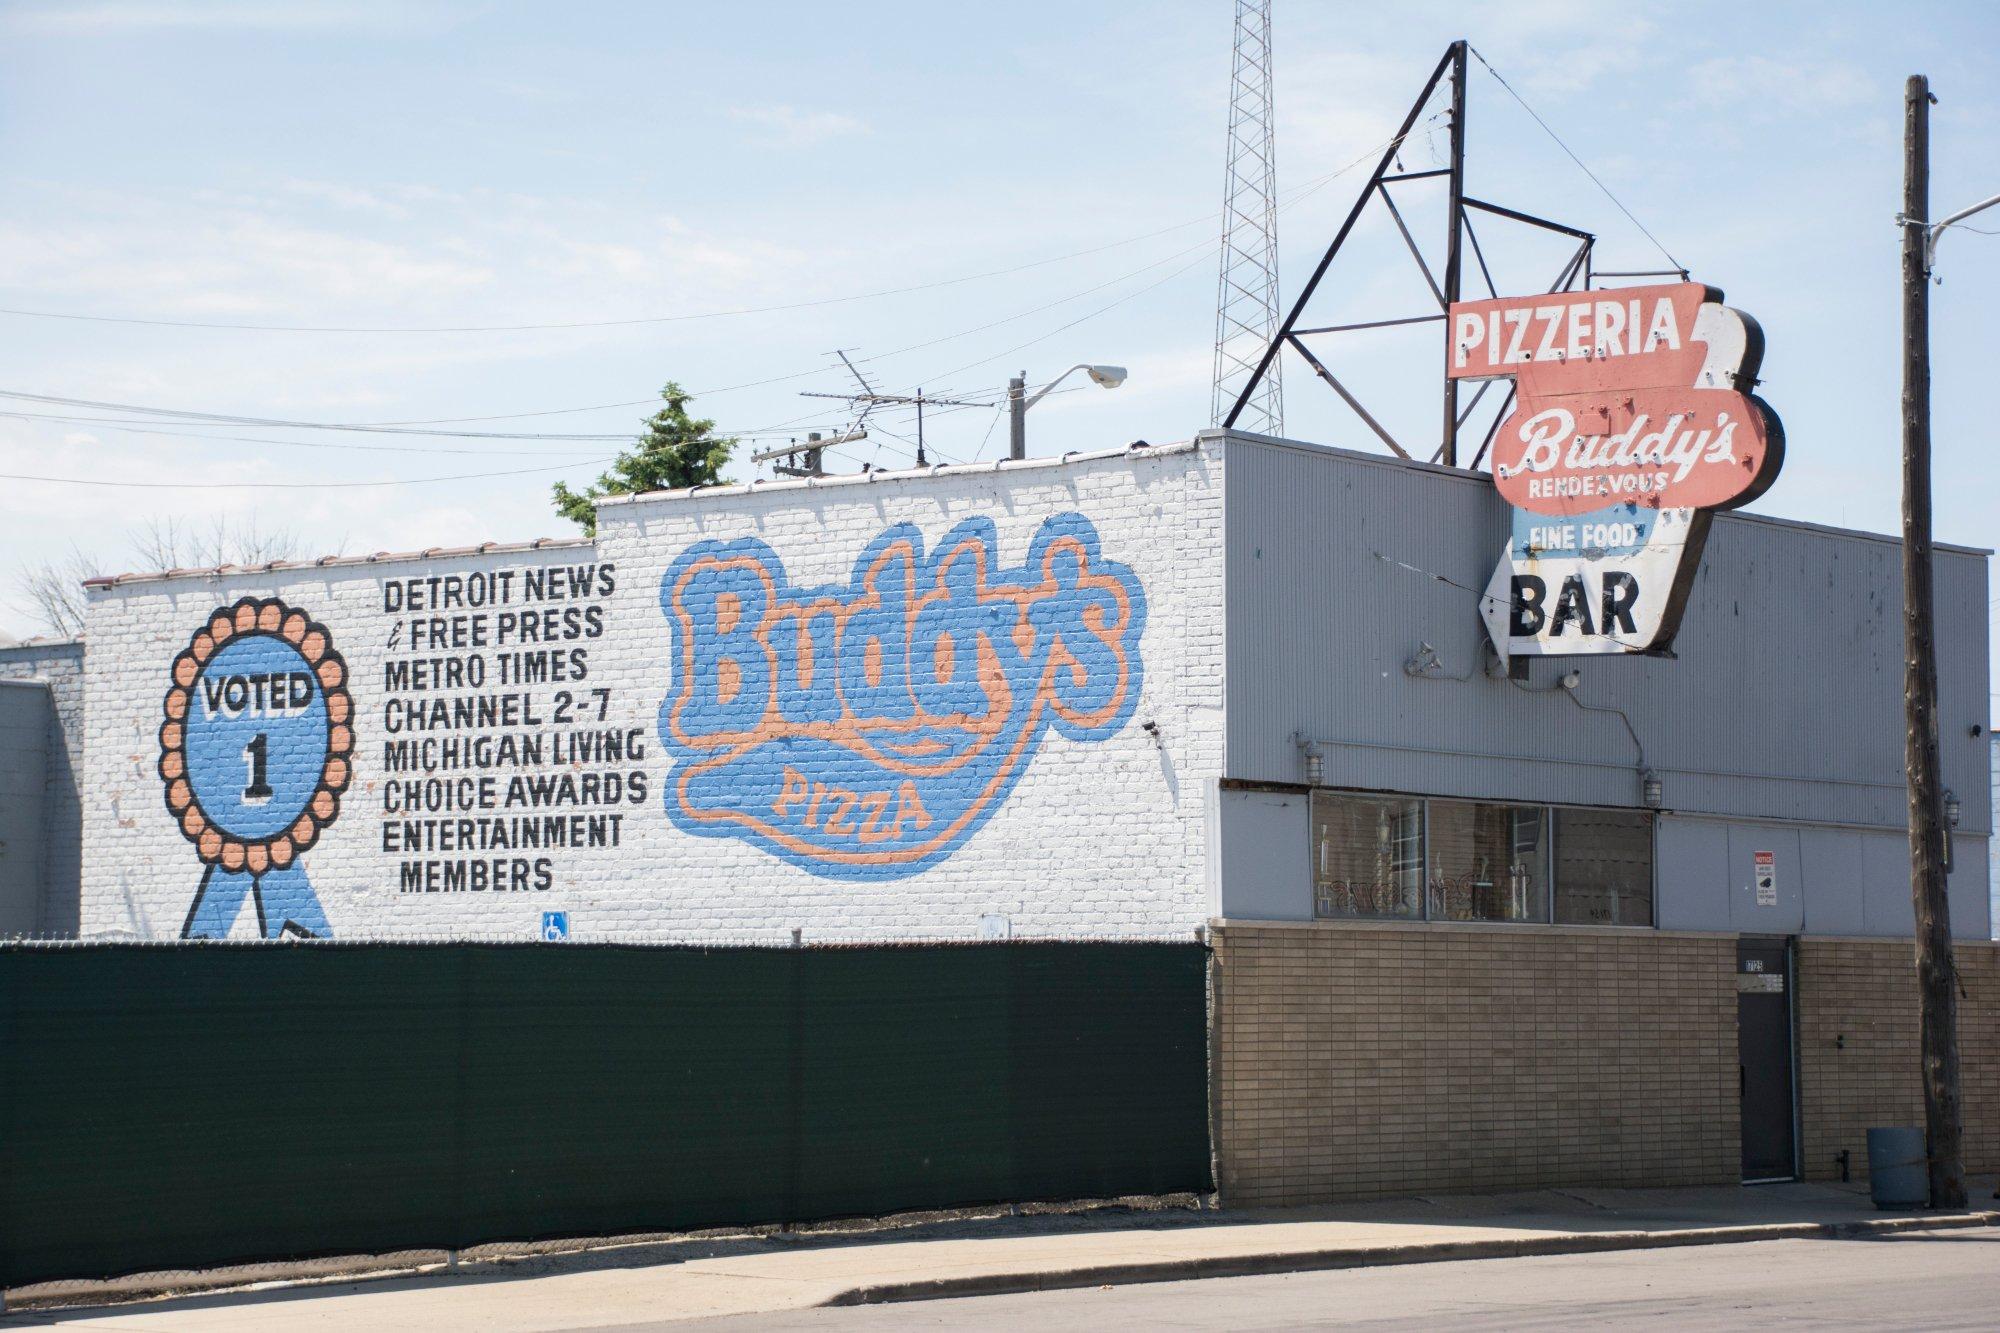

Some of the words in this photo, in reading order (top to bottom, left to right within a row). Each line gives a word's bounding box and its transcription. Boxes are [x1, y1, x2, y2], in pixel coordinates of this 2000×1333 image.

[1454, 298, 1681, 368] PIZZERIA
[1499, 408, 1738, 484] Buddy's
[1529, 473, 1669, 498] RENDEZVOUS
[1530, 526, 1575, 549] FINE
[1582, 522, 1638, 547] FOOD
[384, 570, 515, 613] DETROIT
[525, 564, 616, 602] NEWS
[1509, 571, 1639, 637] BAR
[411, 614, 488, 650] FREE
[499, 606, 603, 645] PRESS
[386, 653, 485, 691] METRO
[497, 648, 589, 685] TIMES
[200, 672, 314, 716] VOTED
[384, 693, 542, 734] CHANNEL
[554, 688, 611, 723] 2-7
[242, 733, 274, 803] 1
[385, 734, 543, 772] MICHIGAN
[553, 728, 645, 765] LIVING
[384, 776, 497, 813] CHOICE
[504, 771, 647, 808] AWARDS
[772, 766, 932, 842] PIZZA
[383, 814, 624, 852] ENTERTAINMENT
[400, 858, 554, 893] MEMBERS
